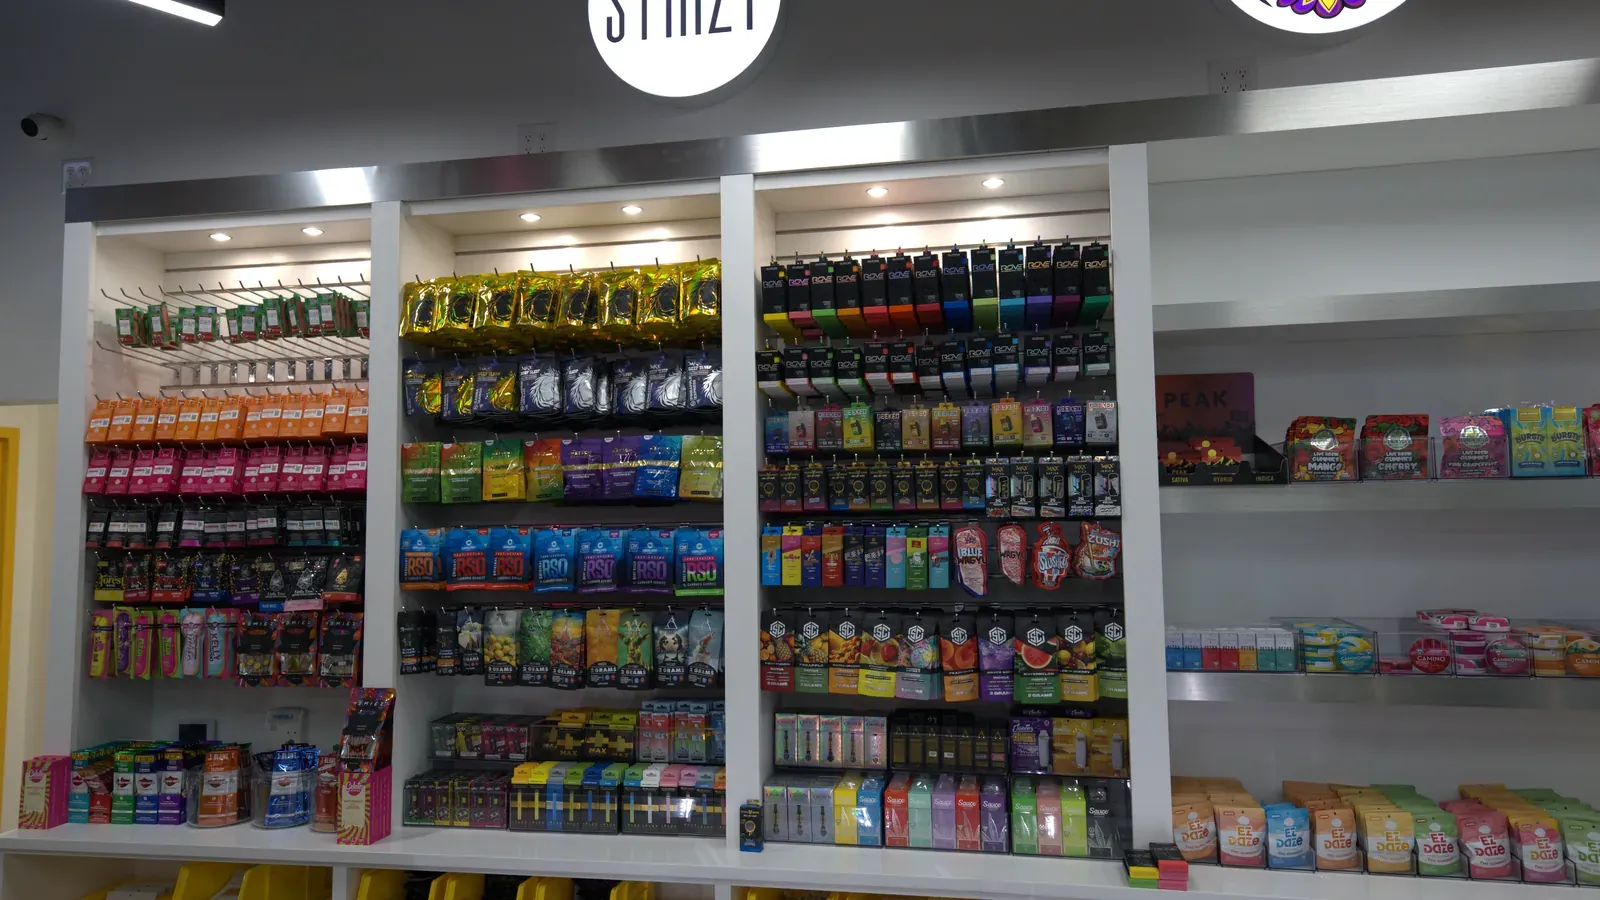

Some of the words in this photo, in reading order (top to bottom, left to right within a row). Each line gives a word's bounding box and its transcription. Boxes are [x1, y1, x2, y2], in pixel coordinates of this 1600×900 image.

[972, 263, 995, 272] ROVE
[1000, 264, 1023, 273] ROVE
[1027, 261, 1050, 270] ROVE
[1056, 260, 1079, 269] ROVE
[1084, 260, 1108, 269] ROVE
[888, 271, 911, 279] ROVE
[915, 270, 937, 278] ROVE
[943, 266, 966, 275] ROVE
[811, 276, 833, 284] ROVE
[836, 275, 857, 283] ROVE
[863, 273, 884, 281] ROVE
[763, 280, 783, 288] ROVE
[788, 279, 809, 287] ROVE
[968, 349, 991, 358] ROVE
[994, 345, 1017, 353] ROVE
[1026, 349, 1049, 357] ROVE
[1055, 347, 1079, 355] ROVE
[1084, 345, 1108, 353] ROVE
[865, 355, 887, 363] ROVE
[890, 355, 912, 363] ROVE
[918, 358, 940, 366] ROVE
[941, 354, 963, 362] ROVE
[757, 363, 779, 371] ROVE
[785, 360, 807, 368] ROVE
[810, 359, 832, 368] ROVE
[837, 361, 859, 369] ROVE
[1163, 390, 1228, 409] PEAK
[1307, 462, 1342, 471] MANGO
[1378, 462, 1418, 471] CHERRY
[1088, 534, 1121, 548] ZUSHI
[407, 557, 434, 577] RSO
[456, 557, 487, 577] RSO
[497, 556, 525, 577] RSO
[542, 558, 569, 579] RSO
[586, 559, 615, 581] RSO
[637, 560, 668, 581] RSO
[686, 561, 717, 582] RSO
[957, 799, 977, 807] Sauce
[982, 800, 1002, 808] Sauce
[1089, 807, 1109, 816] Sauce
[1188, 819, 1202, 831] EZ
[1237, 826, 1253, 837] EZ
[1285, 827, 1297, 838] EZ
[1331, 828, 1345, 839] EZ
[1385, 832, 1401, 842] EZ
[1431, 833, 1447, 843] EZ
[1480, 835, 1496, 846] EZ
[1536, 838, 1551, 850] EZ
